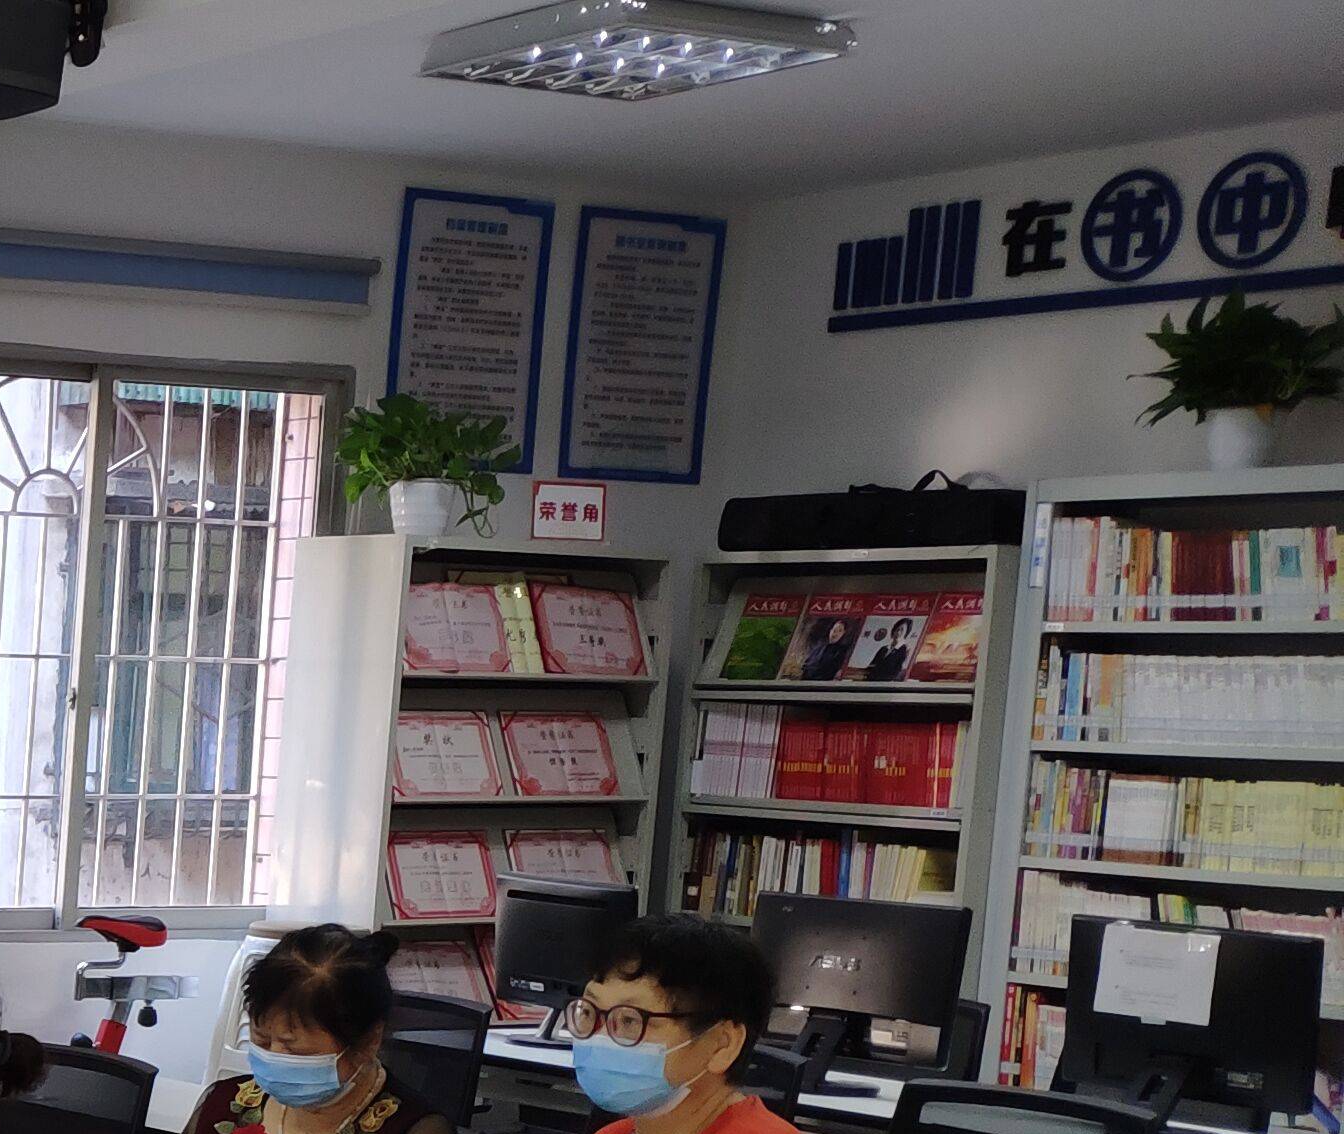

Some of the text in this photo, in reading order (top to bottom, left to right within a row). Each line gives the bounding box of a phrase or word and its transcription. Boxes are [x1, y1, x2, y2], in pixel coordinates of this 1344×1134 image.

[1001, 152, 1344, 283] 在书中
[538, 501, 600, 523] 荣誉角
